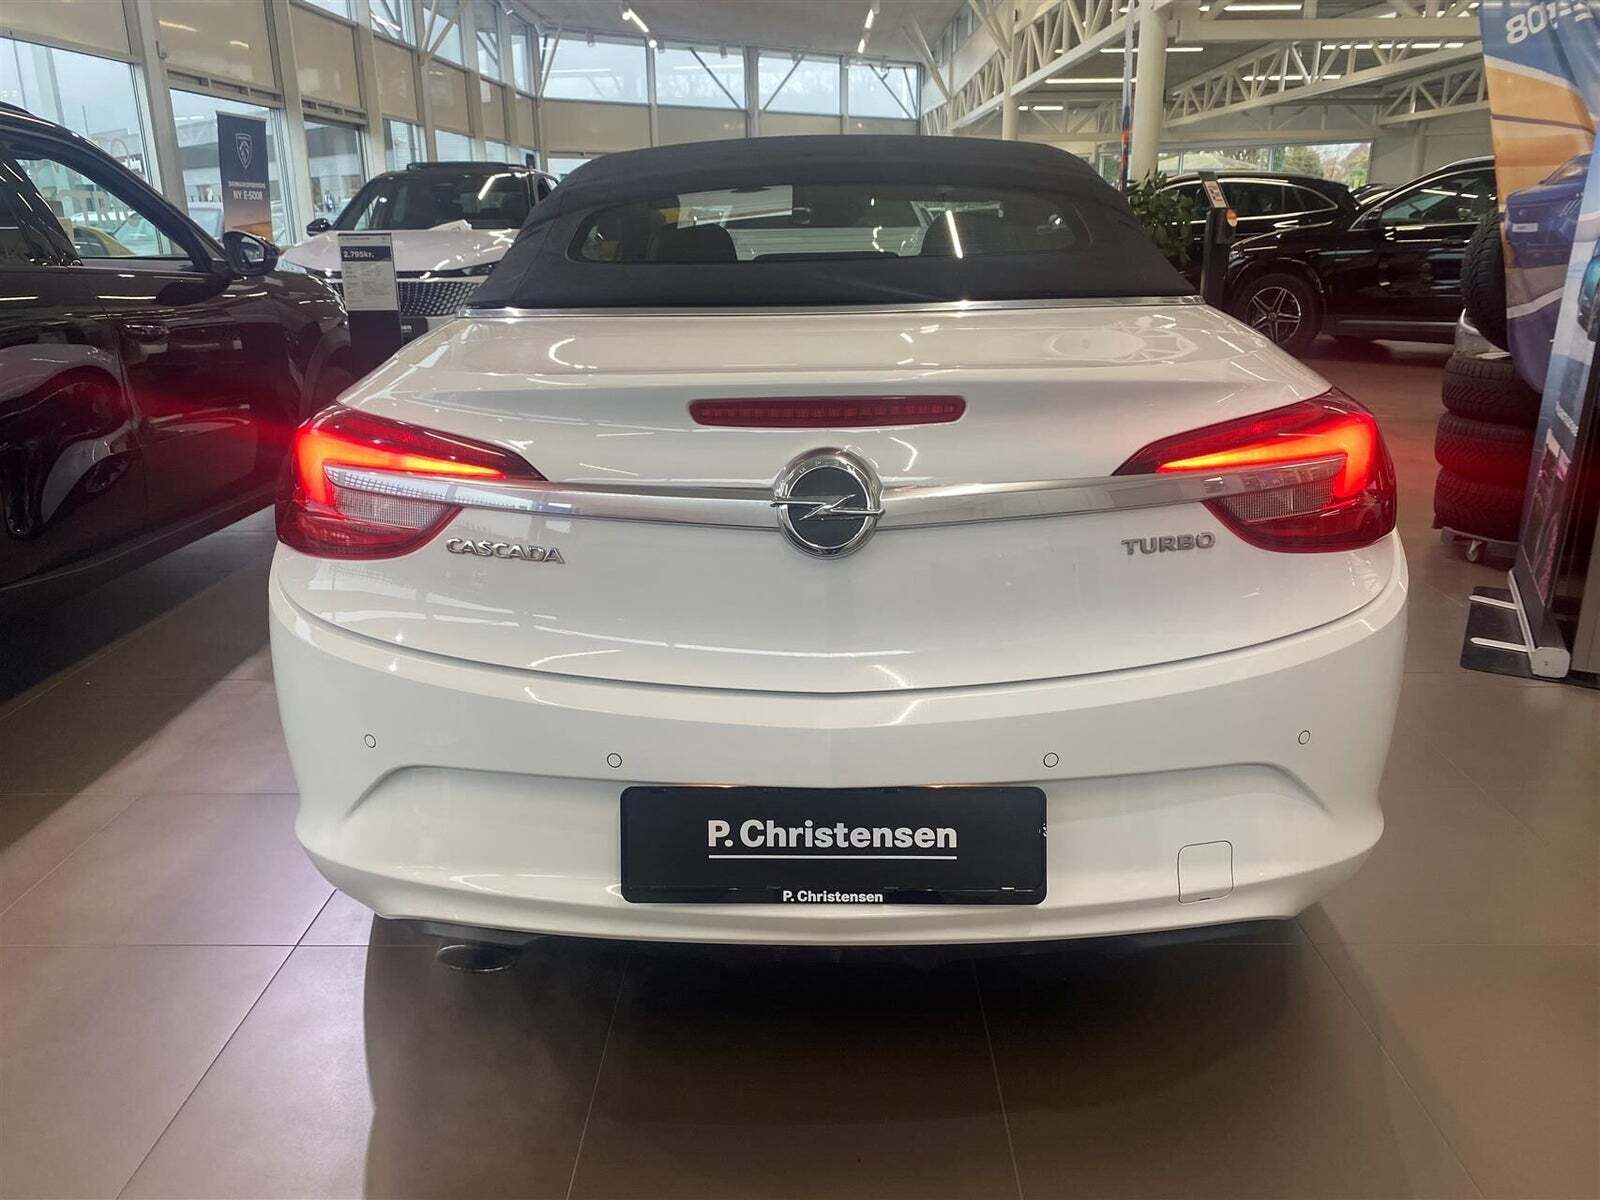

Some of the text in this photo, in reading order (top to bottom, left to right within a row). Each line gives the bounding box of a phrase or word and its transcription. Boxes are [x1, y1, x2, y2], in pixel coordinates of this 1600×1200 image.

[446, 537, 566, 565] CASCADA
[1121, 531, 1216, 556] TURBO
[707, 819, 958, 849] P. Christensen
[782, 889, 884, 904] P. Christensen
